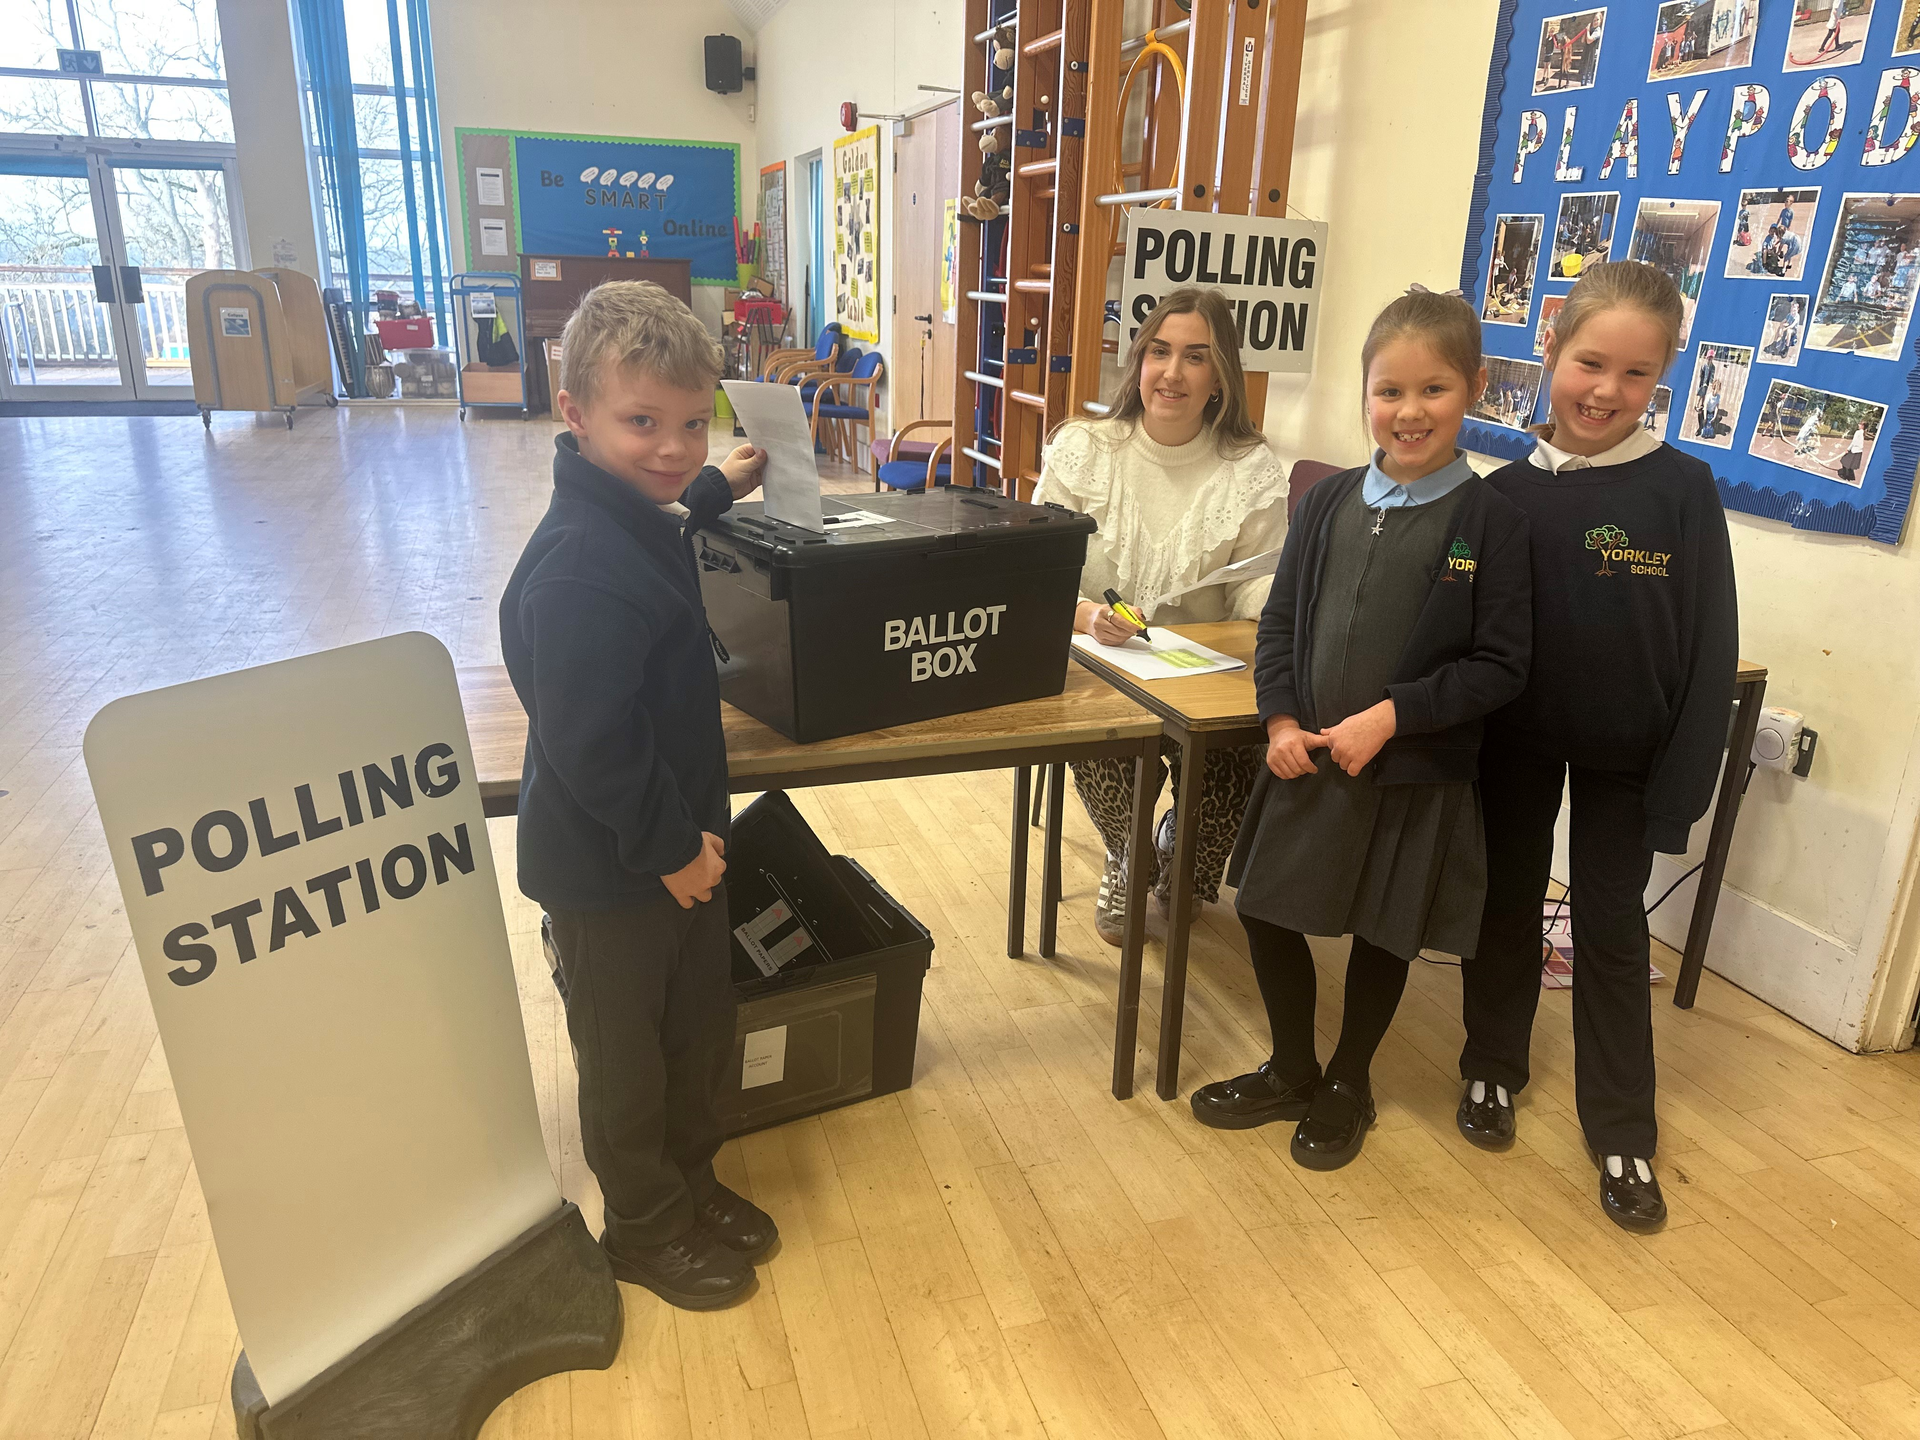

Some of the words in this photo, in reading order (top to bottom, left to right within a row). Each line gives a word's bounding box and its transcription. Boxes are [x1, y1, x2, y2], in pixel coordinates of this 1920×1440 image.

[1511, 66, 1920, 185] PLAYPOD
[540, 170, 565, 188] Be
[842, 146, 869, 174] Golden
[584, 188, 667, 211] SMART
[663, 218, 728, 238] Online
[1134, 227, 1317, 289] POLLING
[1130, 293, 1309, 351] SION
[1601, 549, 1672, 566] YORKLEY
[1630, 564, 1670, 577] SCHOOL
[884, 604, 1007, 652] BALLOT
[911, 643, 978, 683] BOX
[131, 742, 461, 897] POLLING
[162, 822, 475, 987] STATION
[741, 927, 758, 949] BALLOT
[756, 949, 773, 971] PAPERS
